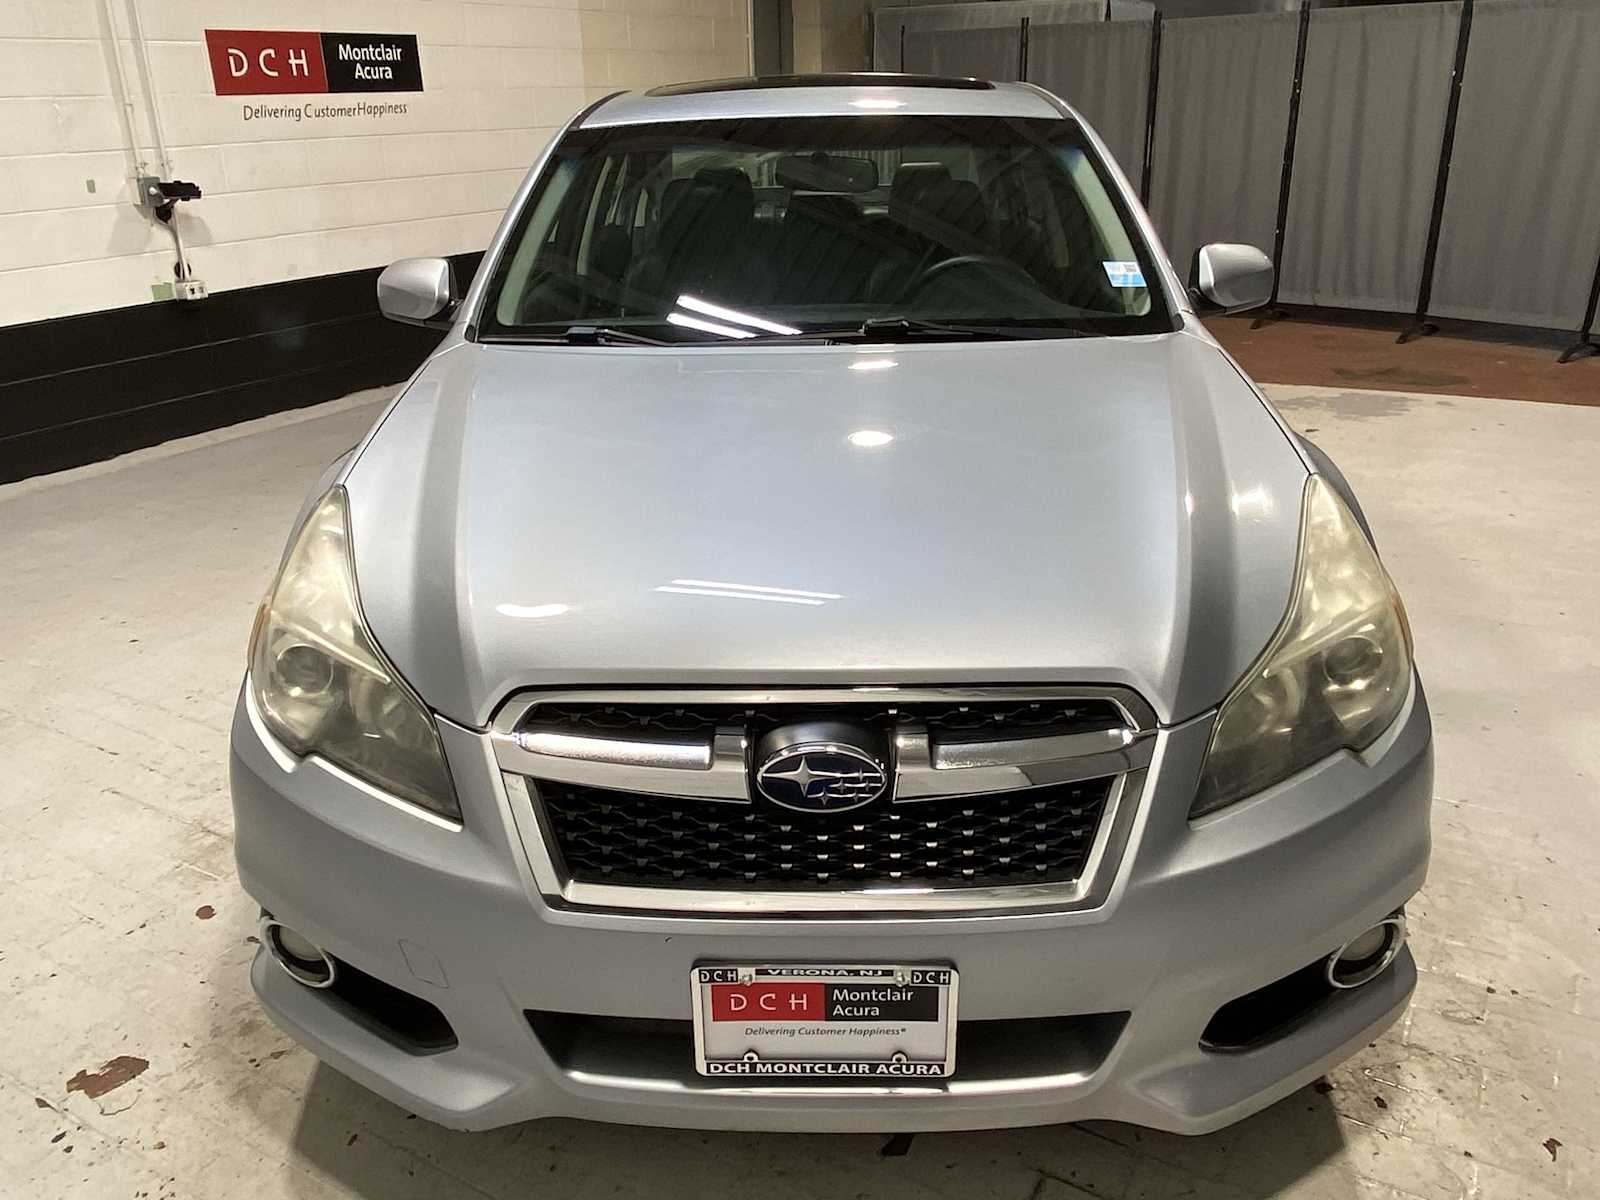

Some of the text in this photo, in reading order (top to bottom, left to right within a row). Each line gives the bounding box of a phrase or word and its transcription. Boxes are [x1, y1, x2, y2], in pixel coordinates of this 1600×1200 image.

[338, 43, 402, 62] Montclair
[227, 48, 309, 77] DCH
[355, 63, 393, 79] Acura
[243, 105, 301, 121] Delivering
[701, 969, 737, 982] DCH
[860, 969, 883, 977] NJ
[913, 971, 950, 984] DCH
[833, 988, 914, 1002] Montclair
[730, 993, 808, 1011] DCH
[833, 1004, 880, 1017] Acura
[744, 1027, 796, 1037] Delivering
[798, 1027, 847, 1036] Customer
[709, 1063, 942, 1075] DCH MONTCLAIR ACURA
